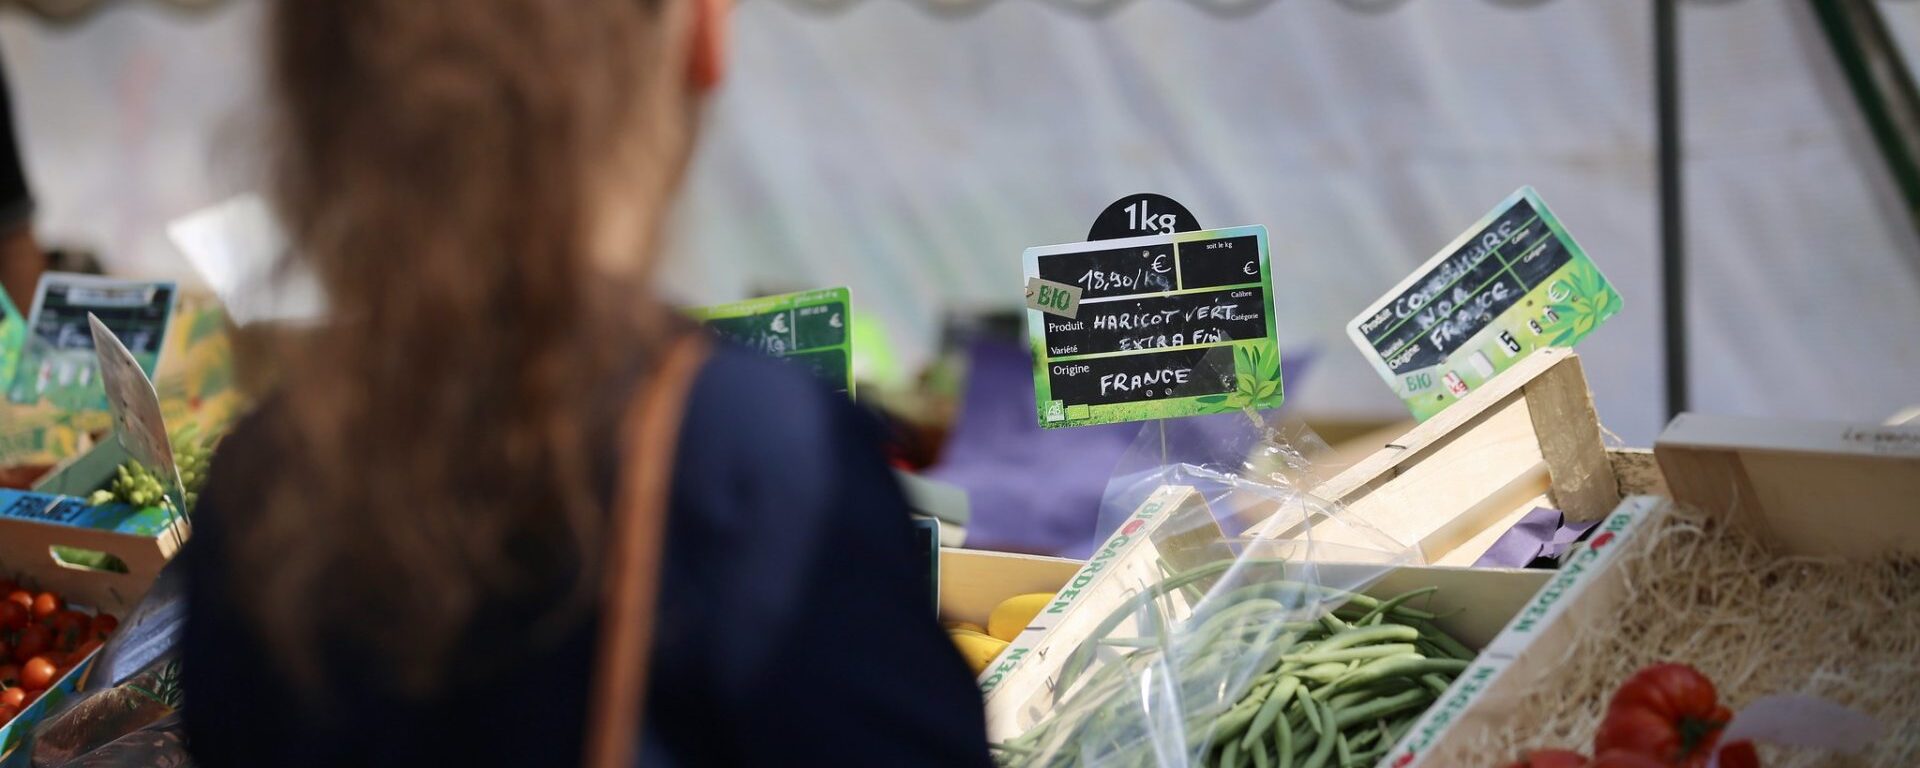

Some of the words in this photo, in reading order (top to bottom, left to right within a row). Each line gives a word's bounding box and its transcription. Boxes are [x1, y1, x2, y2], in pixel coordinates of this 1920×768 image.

[1123, 199, 1177, 235] 1kg
[1206, 242, 1217, 250] soit
[1218, 241, 1224, 249] le
[1225, 241, 1233, 249] kg
[1151, 254, 1172, 273] €
[1243, 261, 1258, 275] €
[1037, 284, 1071, 311] BIO
[1547, 280, 1571, 303] €
[1093, 309, 1180, 330] HARICOT
[1230, 313, 1259, 321] Catégorie
[1048, 321, 1084, 333] Produit
[1050, 344, 1078, 355] Variété
[1119, 333, 1184, 351] EXTRA
[1500, 331, 1521, 353] 5
[1053, 364, 1090, 377] Origine
[1100, 368, 1192, 396] FRANCE
[1405, 373, 1432, 392] BIO
